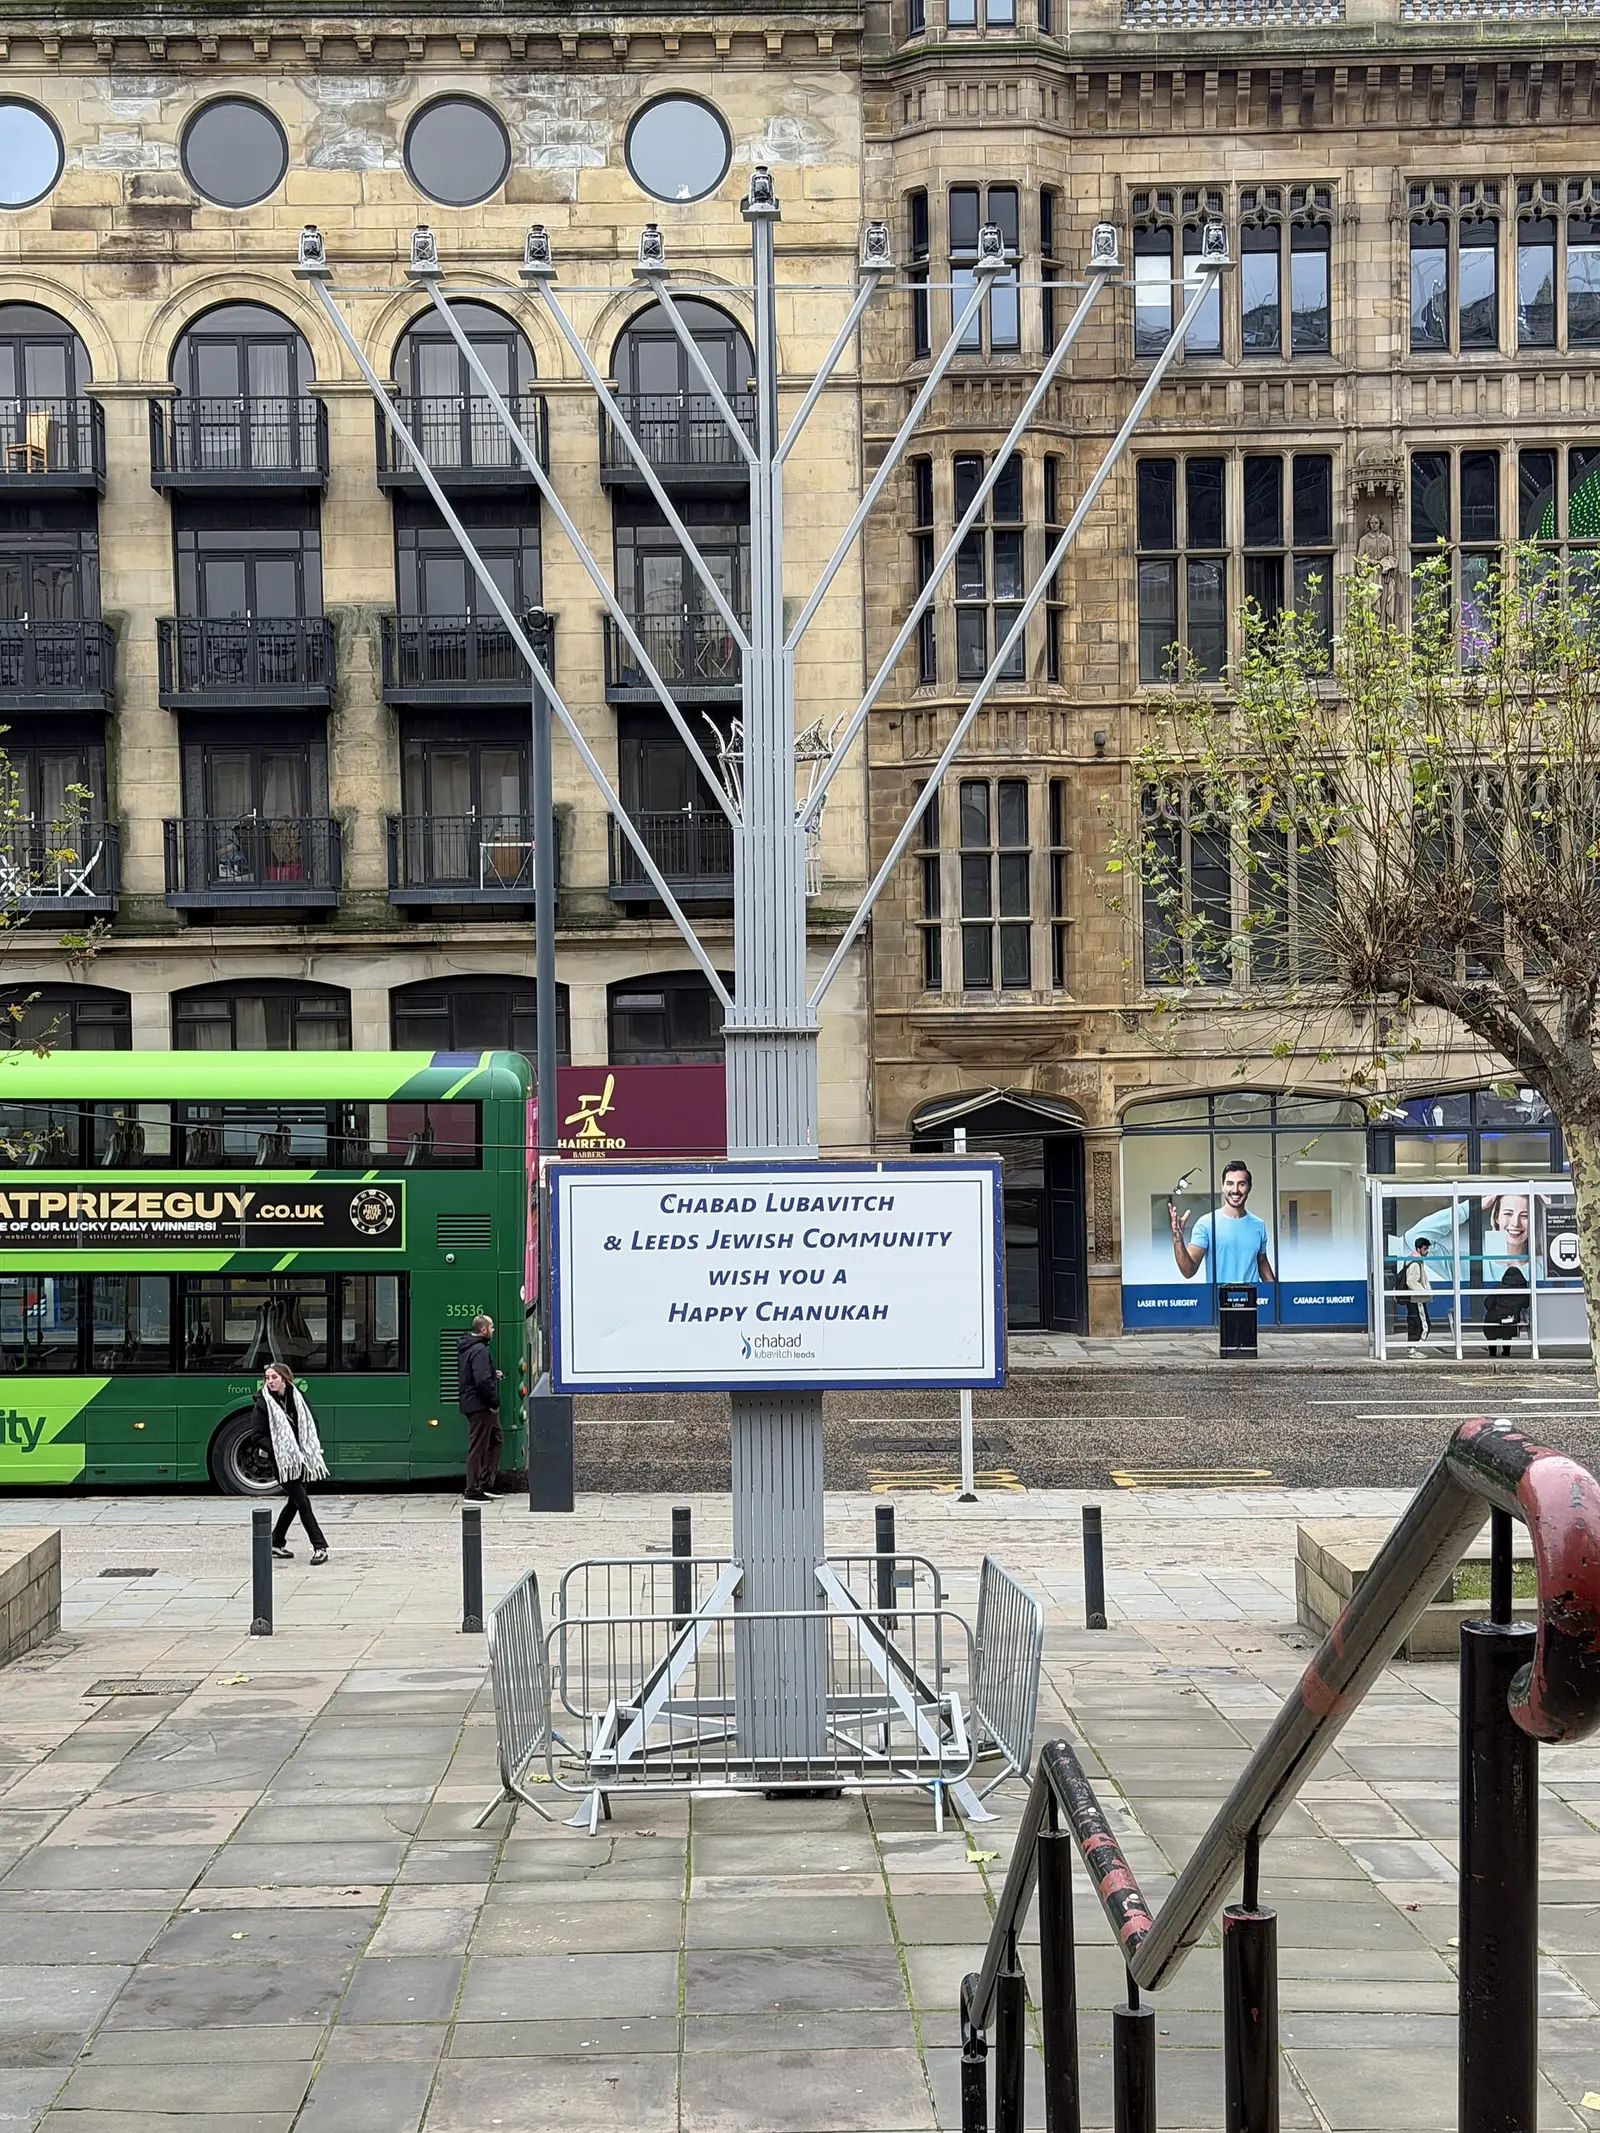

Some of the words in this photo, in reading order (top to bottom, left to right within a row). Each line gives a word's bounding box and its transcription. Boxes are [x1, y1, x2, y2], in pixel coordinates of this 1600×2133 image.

[660, 1193, 757, 1214] CHABAD
[765, 1192, 895, 1213] LUBAVITCH
[10, 1222, 29, 1231] OF
[31, 1222, 60, 1231] OUR
[62, 1222, 108, 1231] LUCKY
[110, 1222, 148, 1231] DAILY
[151, 1222, 217, 1231] WINNERS!
[603, 1234, 621, 1250] &
[631, 1231, 699, 1250] LEEDS
[706, 1230, 794, 1249] JEWISH
[802, 1228, 953, 1249] COMMUNITY
[709, 1269, 769, 1286] WISH
[779, 1269, 825, 1285] YOU
[832, 1269, 847, 1285] A
[1157, 1299, 1169, 1307] EYE
[1170, 1299, 1198, 1307] SURGERY
[1326, 1296, 1354, 1304] SURGERY
[446, 1304, 484, 1317] 35536
[668, 1303, 748, 1323] HAPPY
[755, 1301, 889, 1322] CHANUKAH
[754, 1333, 802, 1348] chabad
[754, 1349, 793, 1359] lubavitch
[794, 1351, 816, 1359] leeds
[228, 1384, 251, 1394] from
